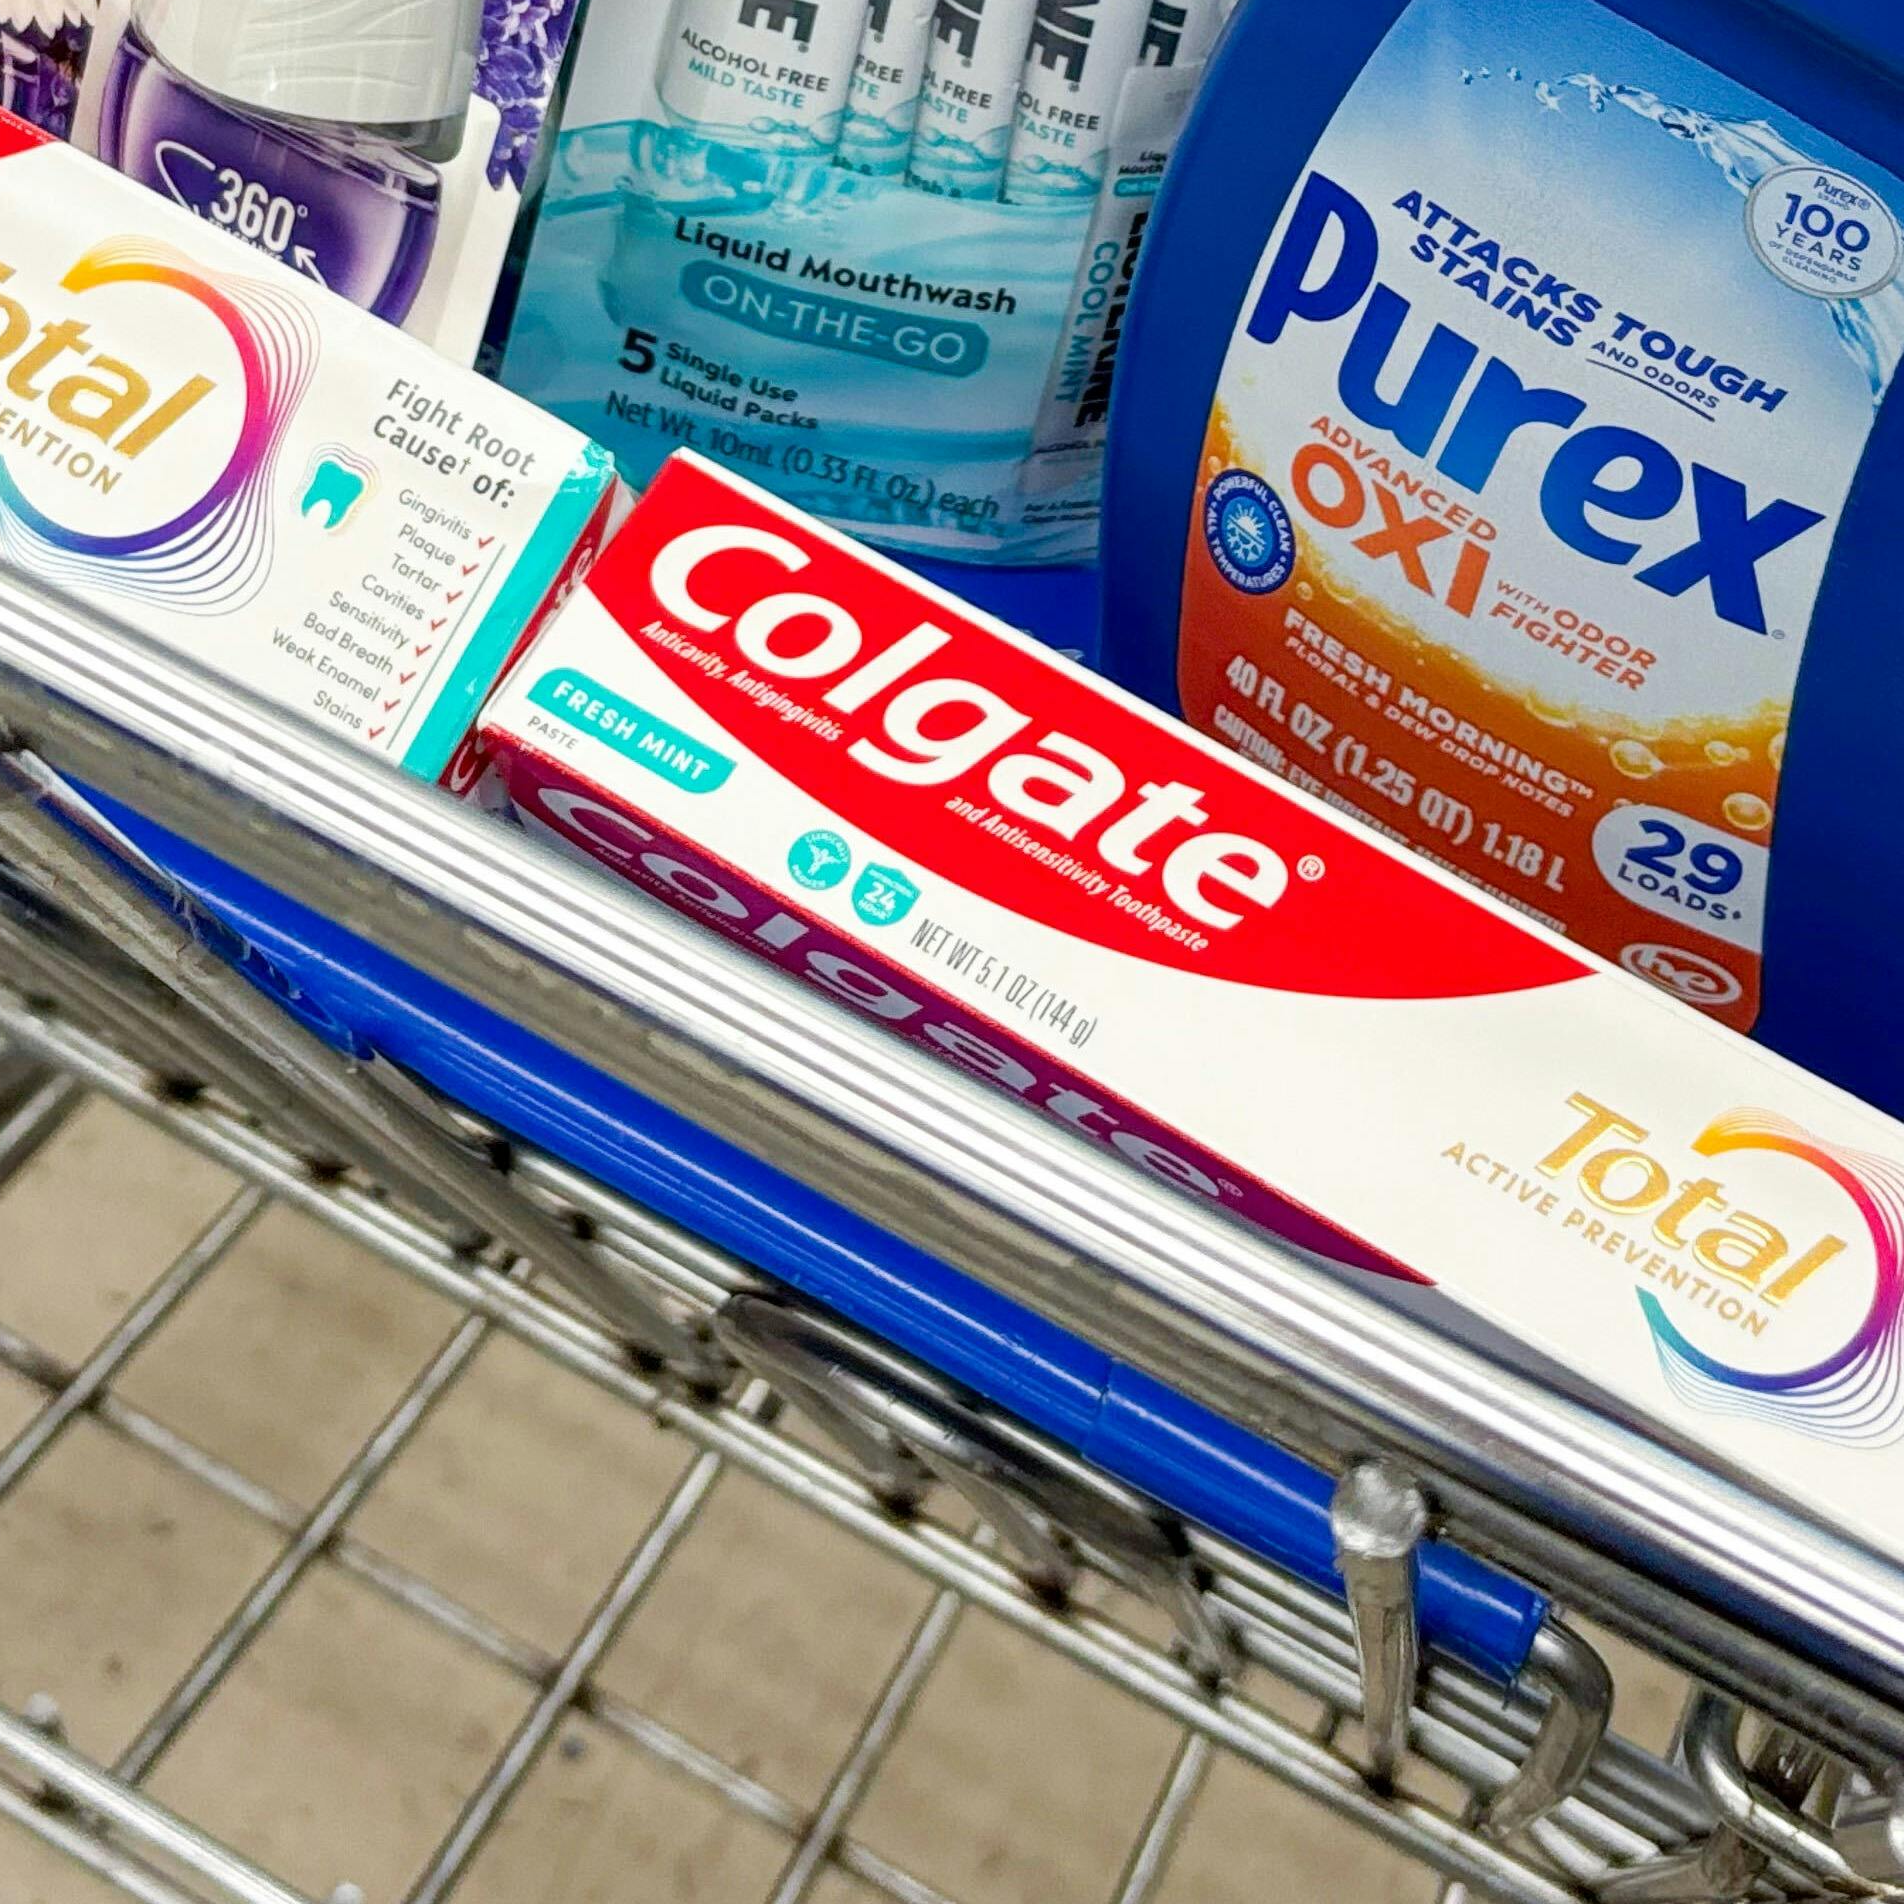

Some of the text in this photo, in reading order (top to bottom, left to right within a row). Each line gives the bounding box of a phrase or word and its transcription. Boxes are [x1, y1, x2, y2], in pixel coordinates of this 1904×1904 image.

[681, 27, 769, 80] ALCOHOL
[776, 66, 830, 93] FREE
[1776, 222, 1863, 271] YEARS
[1785, 192, 1871, 253] 100
[674, 217, 1019, 316] Liquid Mouthwash
[1393, 190, 1789, 413] ATTACKS TOUGH
[704, 274, 967, 365] ON-THE-GO
[1410, 233, 1720, 411] STAINS AND ODORS
[619, 328, 800, 403] 5 Single Use
[661, 368, 820, 431] Liquid Packs
[385, 378, 536, 476] Fight Root
[398, 488, 473, 541] Gingivitis
[472, 475, 516, 508] of:
[1213, 475, 1291, 552] POWERFUL CLEAN
[1310, 416, 1496, 542] ADVANCED
[398, 523, 456, 567] Plaque
[1291, 443, 1491, 618] OXI
[361, 574, 425, 621] Cavities
[392, 554, 442, 593] Tartar
[303, 612, 394, 675] Bad Breath
[329, 591, 410, 649] Sensitivity
[1284, 607, 1392, 694] FRESH
[1488, 602, 1646, 693] FIGHTER
[1496, 579, 1657, 669] WITH ODOR
[272, 627, 382, 702] Weak Enamel
[639, 620, 844, 744] Anticavity, Antigingivitis
[313, 689, 364, 731] Stains
[527, 715, 579, 750] PASTE
[551, 680, 713, 783] FRESH MINT
[1285, 637, 1575, 817] FLORAL DEW DROP NOTES
[1226, 656, 1566, 893] 40 FL OZ (1.25 QT) 1.18 L
[864, 880, 896, 912] 24
[944, 796, 984, 828] and
[983, 810, 1110, 900] Antisensitivity
[1105, 885, 1210, 956] Toothpaste
[1621, 819, 1743, 895] 29
[911, 918, 1074, 1031] NET WT 5.1 OZ (144
[1536, 1091, 1847, 1304] Total
[1442, 1140, 1769, 1338] ACTIVE PREVENTION
